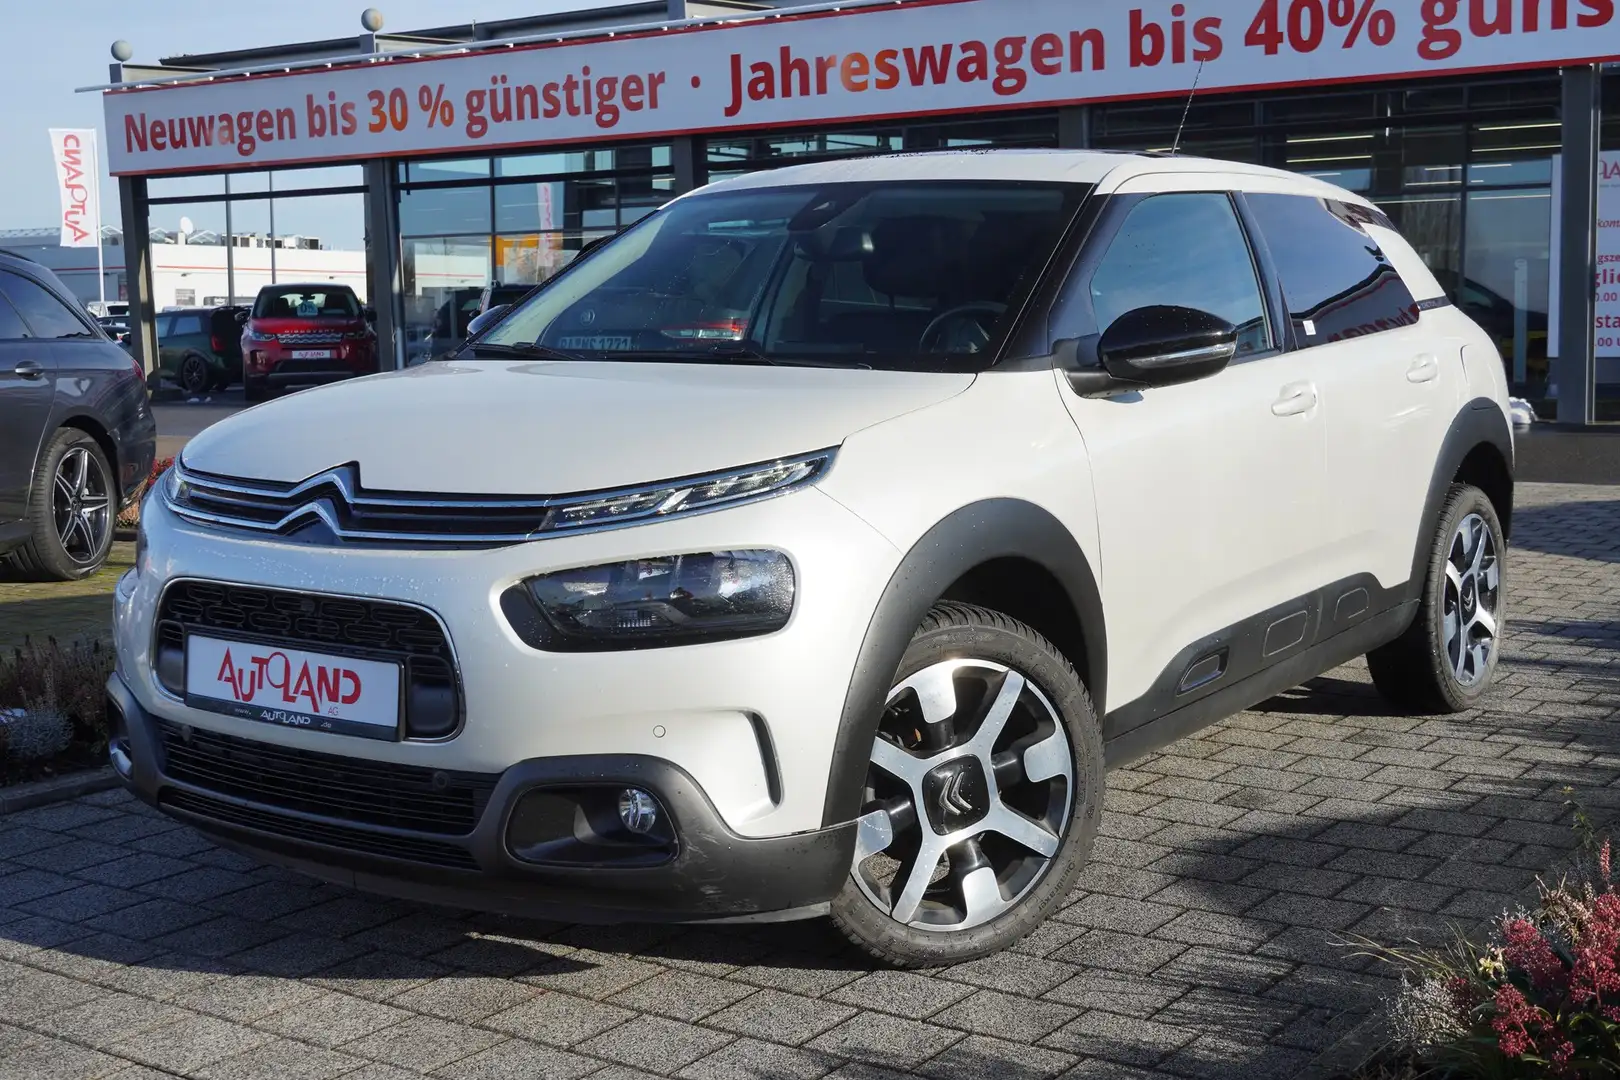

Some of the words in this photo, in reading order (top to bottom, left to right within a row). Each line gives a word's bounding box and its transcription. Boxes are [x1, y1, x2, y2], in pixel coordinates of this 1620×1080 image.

[724, 27, 1106, 117] Jahreswagen
[1129, 3, 1224, 69] bis
[1244, 0, 1396, 56] 40%
[123, 106, 297, 157] Neuwagen
[306, 90, 358, 139] bis
[367, 87, 408, 133] 30
[418, 84, 455, 128] %
[465, 65, 666, 139] günstiger
[217, 646, 361, 713] AUTOLAND
[327, 706, 339, 716] AG
[260, 709, 311, 725] AUTOLAND
